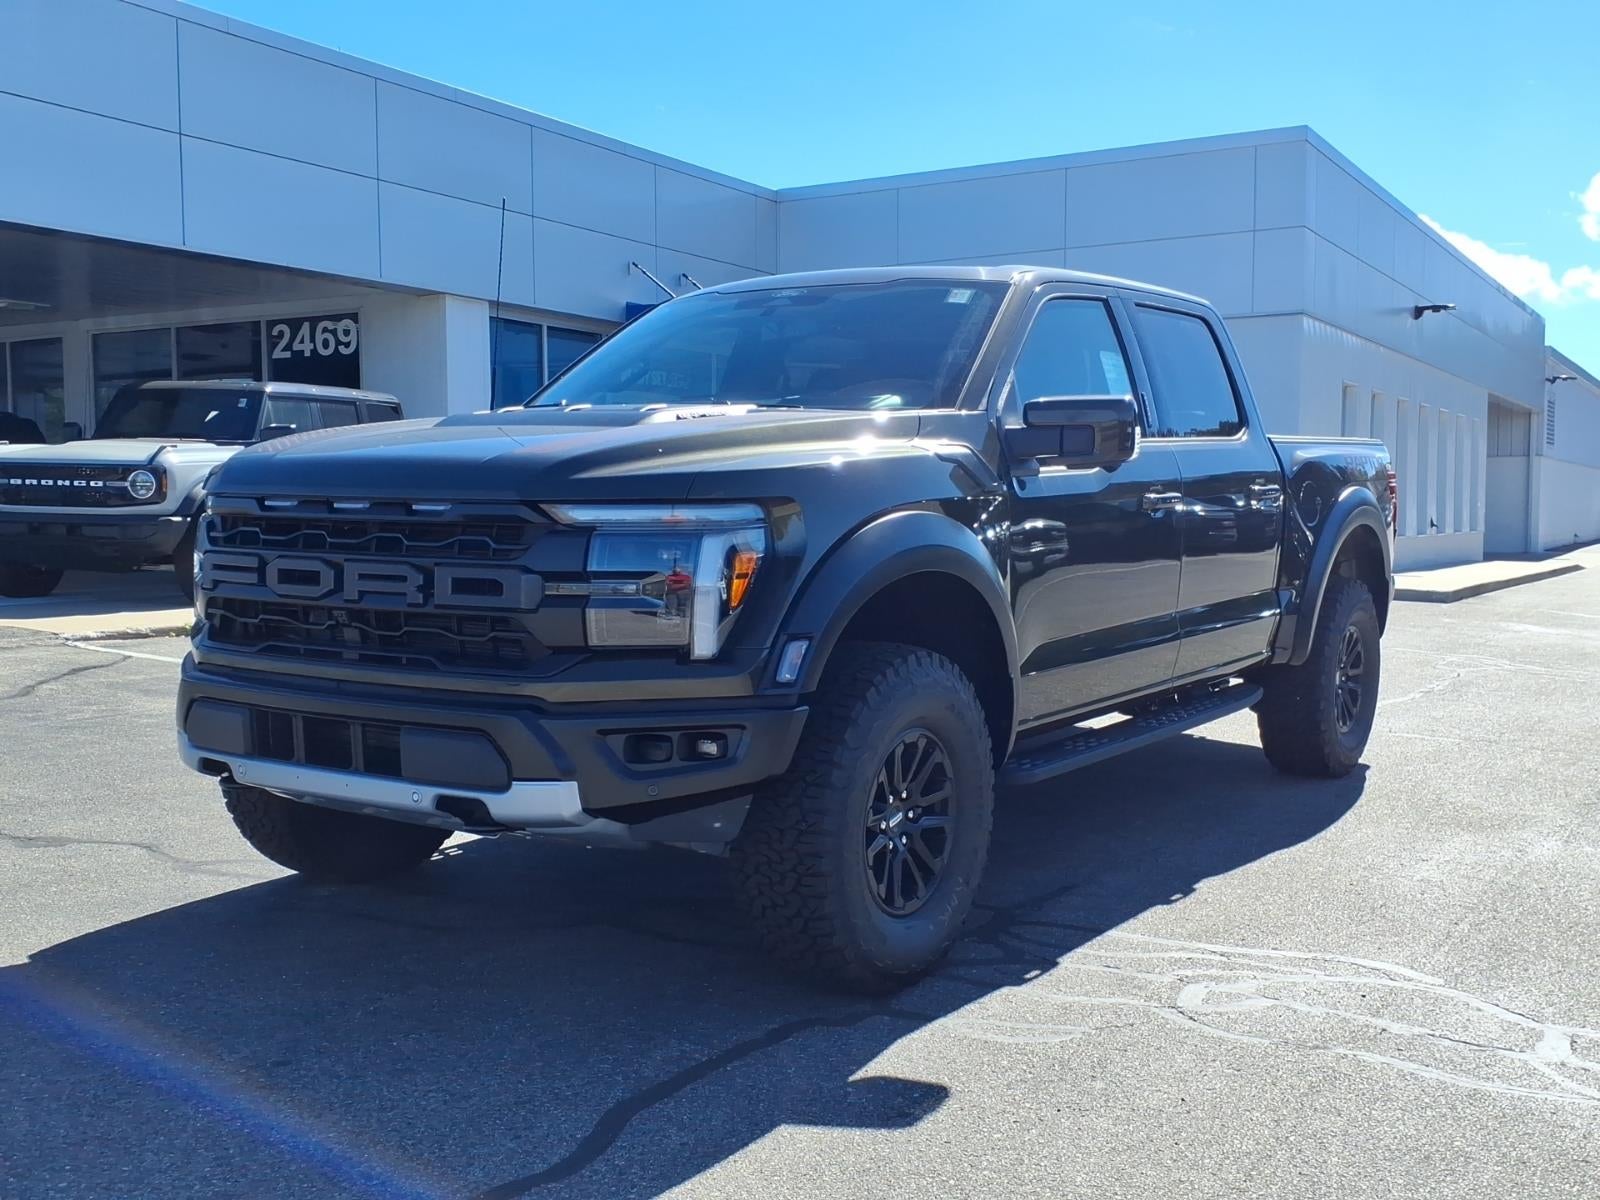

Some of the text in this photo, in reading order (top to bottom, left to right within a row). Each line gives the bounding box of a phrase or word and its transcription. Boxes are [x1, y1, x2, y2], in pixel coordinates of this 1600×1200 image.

[271, 319, 358, 359] 2469
[9, 478, 104, 487] BRONCO
[200, 552, 543, 610] FORD
